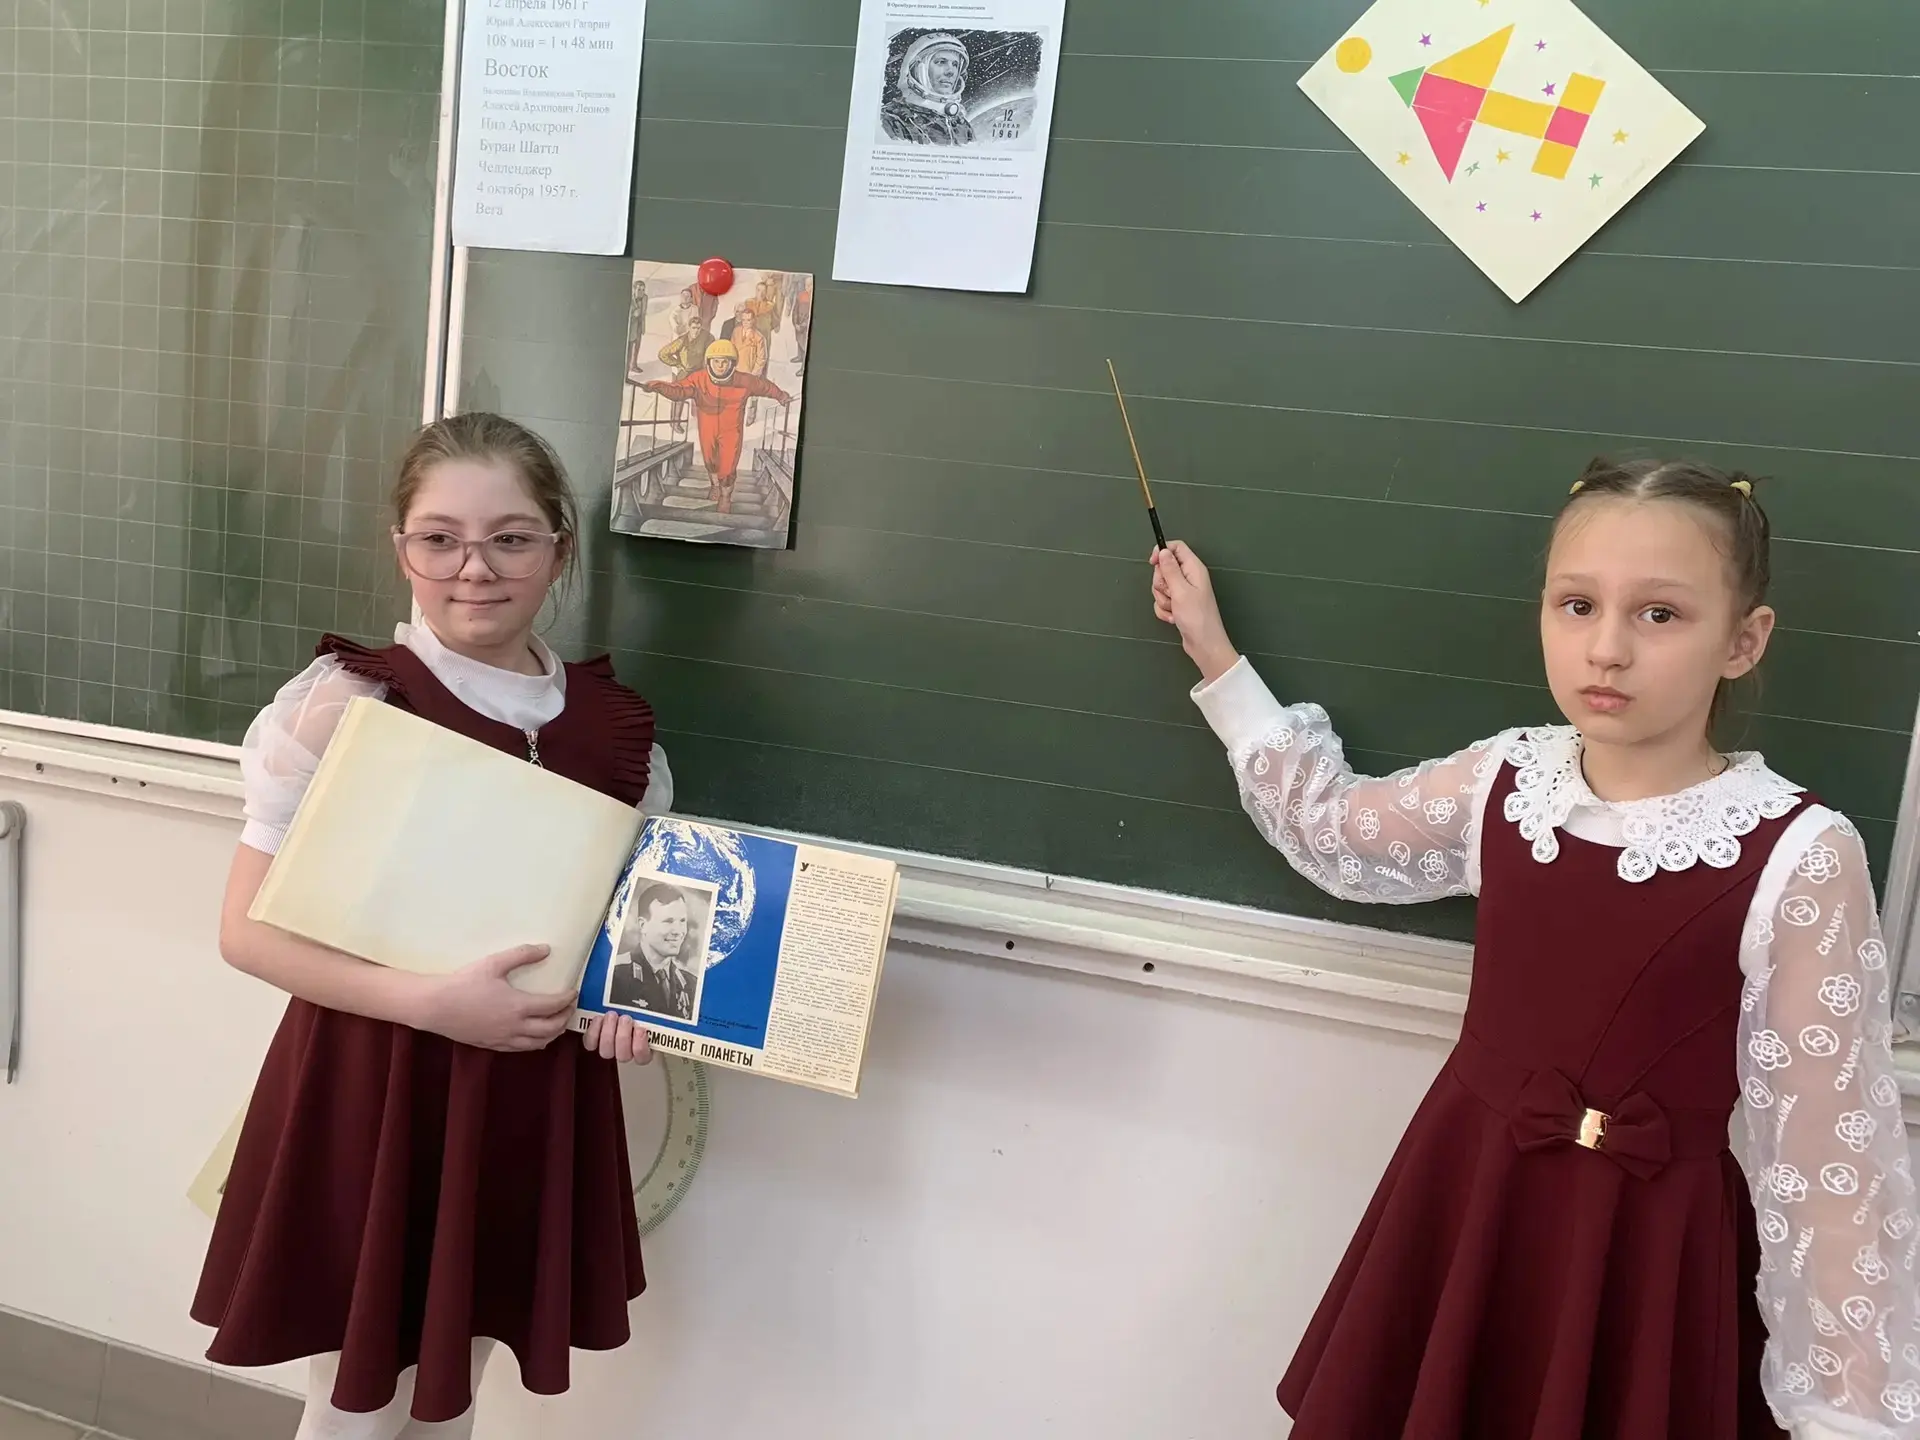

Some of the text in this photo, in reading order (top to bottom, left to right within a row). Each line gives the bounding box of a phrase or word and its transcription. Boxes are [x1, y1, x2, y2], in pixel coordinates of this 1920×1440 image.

[504, 0, 546, 11] апреля
[551, 0, 577, 10] 1961
[486, 16, 515, 28] Юрий
[573, 19, 610, 31] Гагарин
[486, 34, 507, 47] 108
[510, 38, 535, 48] мин
[551, 36, 556, 49] 1
[571, 36, 585, 49] 48
[588, 40, 614, 50] мин
[484, 58, 549, 78] Восток
[482, 100, 611, 114] Алексей Архипович Леонов
[1003, 109, 1014, 121] 12
[508, 119, 576, 135] Армстронг
[992, 128, 1019, 139] 1961
[479, 138, 560, 155] Буран Шаттл
[478, 159, 553, 179] Челленджер
[476, 181, 484, 193] 4
[486, 183, 536, 199] октября
[540, 184, 567, 198] 1957
[475, 202, 504, 216] Вега
[1374, 865, 1415, 888] CHANEL
[1815, 901, 1848, 956] CHANEL
[1742, 963, 1777, 1012] CHANEL
[646, 1030, 753, 1066] СМОНАВТ ПЛАНЕТЫ
[1834, 1036, 1863, 1092] CHANEL
[1790, 1226, 1814, 1278] CHANEL
